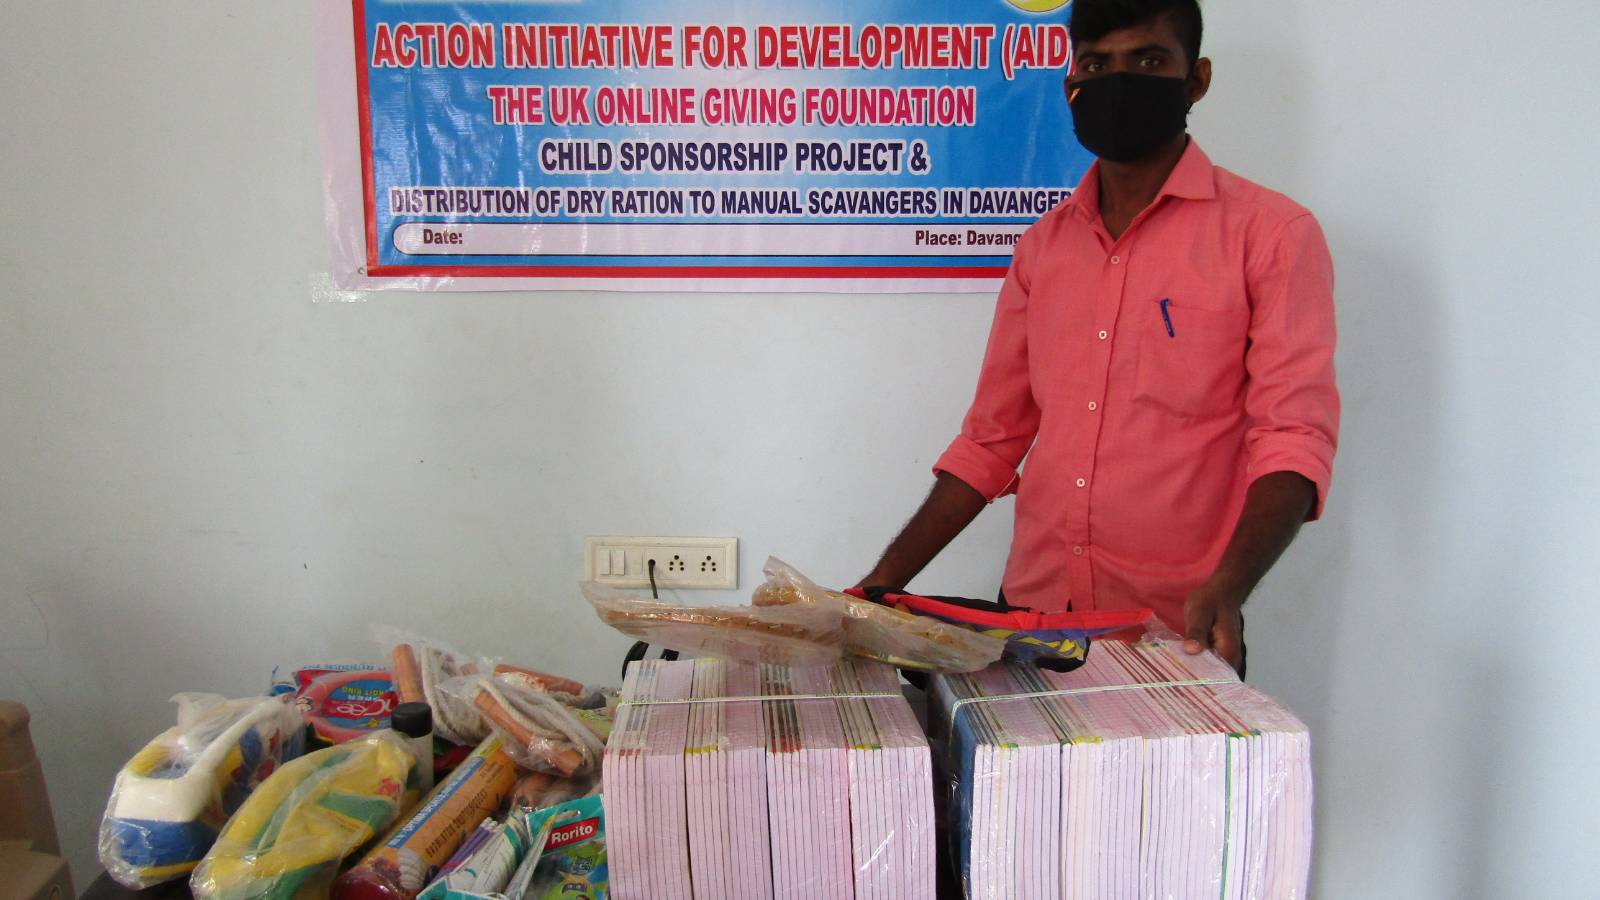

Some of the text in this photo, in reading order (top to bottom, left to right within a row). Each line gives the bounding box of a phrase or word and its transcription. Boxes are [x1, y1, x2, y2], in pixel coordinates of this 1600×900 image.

[373, 25, 494, 66] ACTION
[504, 25, 674, 67] INITIATIVE
[684, 26, 748, 68] FOR
[757, 26, 994, 69] DEVELOPMENT
[489, 87, 975, 125] THE UK ONLINE GIVING FOUNDATION
[541, 142, 928, 172] CHILD SPONSORSHIP PROJECT &
[391, 189, 529, 214] DISTRIBUTION
[535, 189, 561, 214] OF
[567, 190, 606, 214] DRY
[611, 190, 684, 214] RATION
[688, 190, 715, 215] TO
[721, 190, 803, 215] MANUAL
[808, 190, 937, 215] SCAVANGERS
[943, 190, 963, 214] IN
[423, 228, 463, 245] Date:
[915, 230, 962, 246] Place:
[551, 825, 594, 845] Rorito
